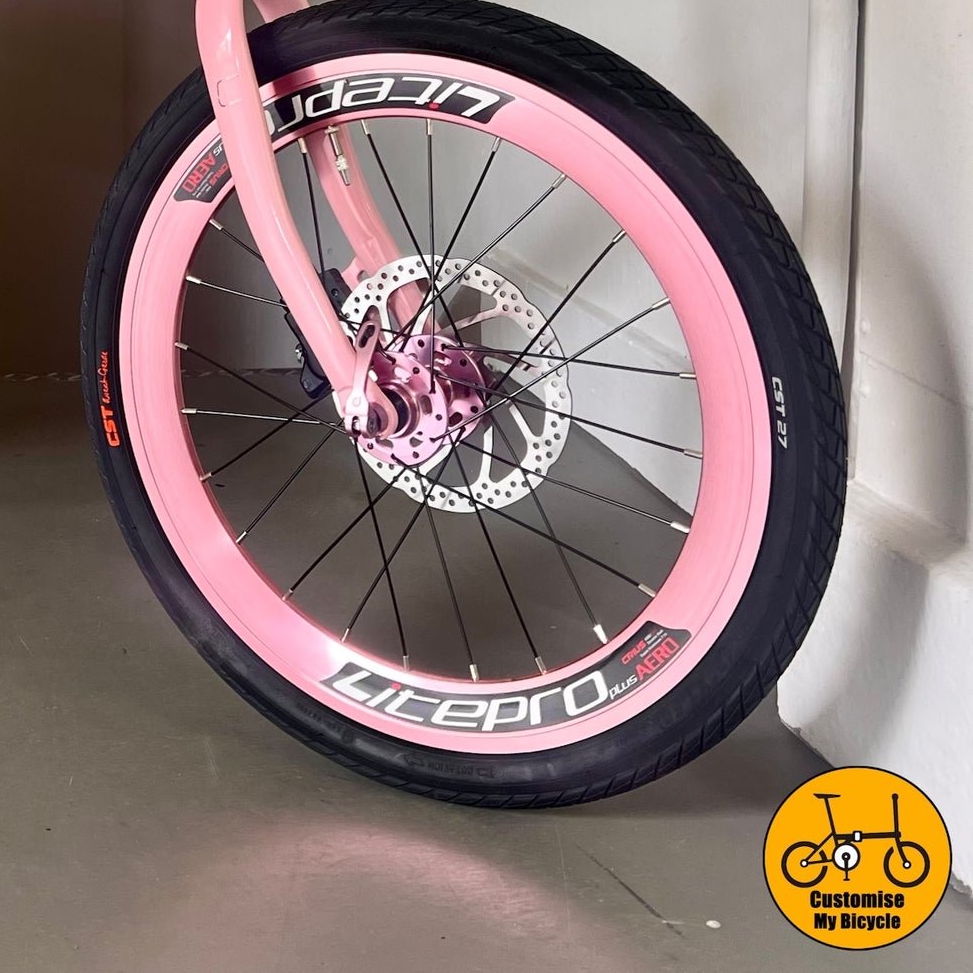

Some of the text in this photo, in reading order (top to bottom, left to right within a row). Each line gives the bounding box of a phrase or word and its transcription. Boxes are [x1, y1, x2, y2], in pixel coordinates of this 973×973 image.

[263, 76, 502, 137] Litepr
[181, 151, 217, 194] AERO
[100, 405, 121, 447] CST
[771, 376, 788, 450] CST 27
[331, 670, 610, 732] Litepro
[608, 674, 638, 701] plus
[635, 636, 680, 682] AERO
